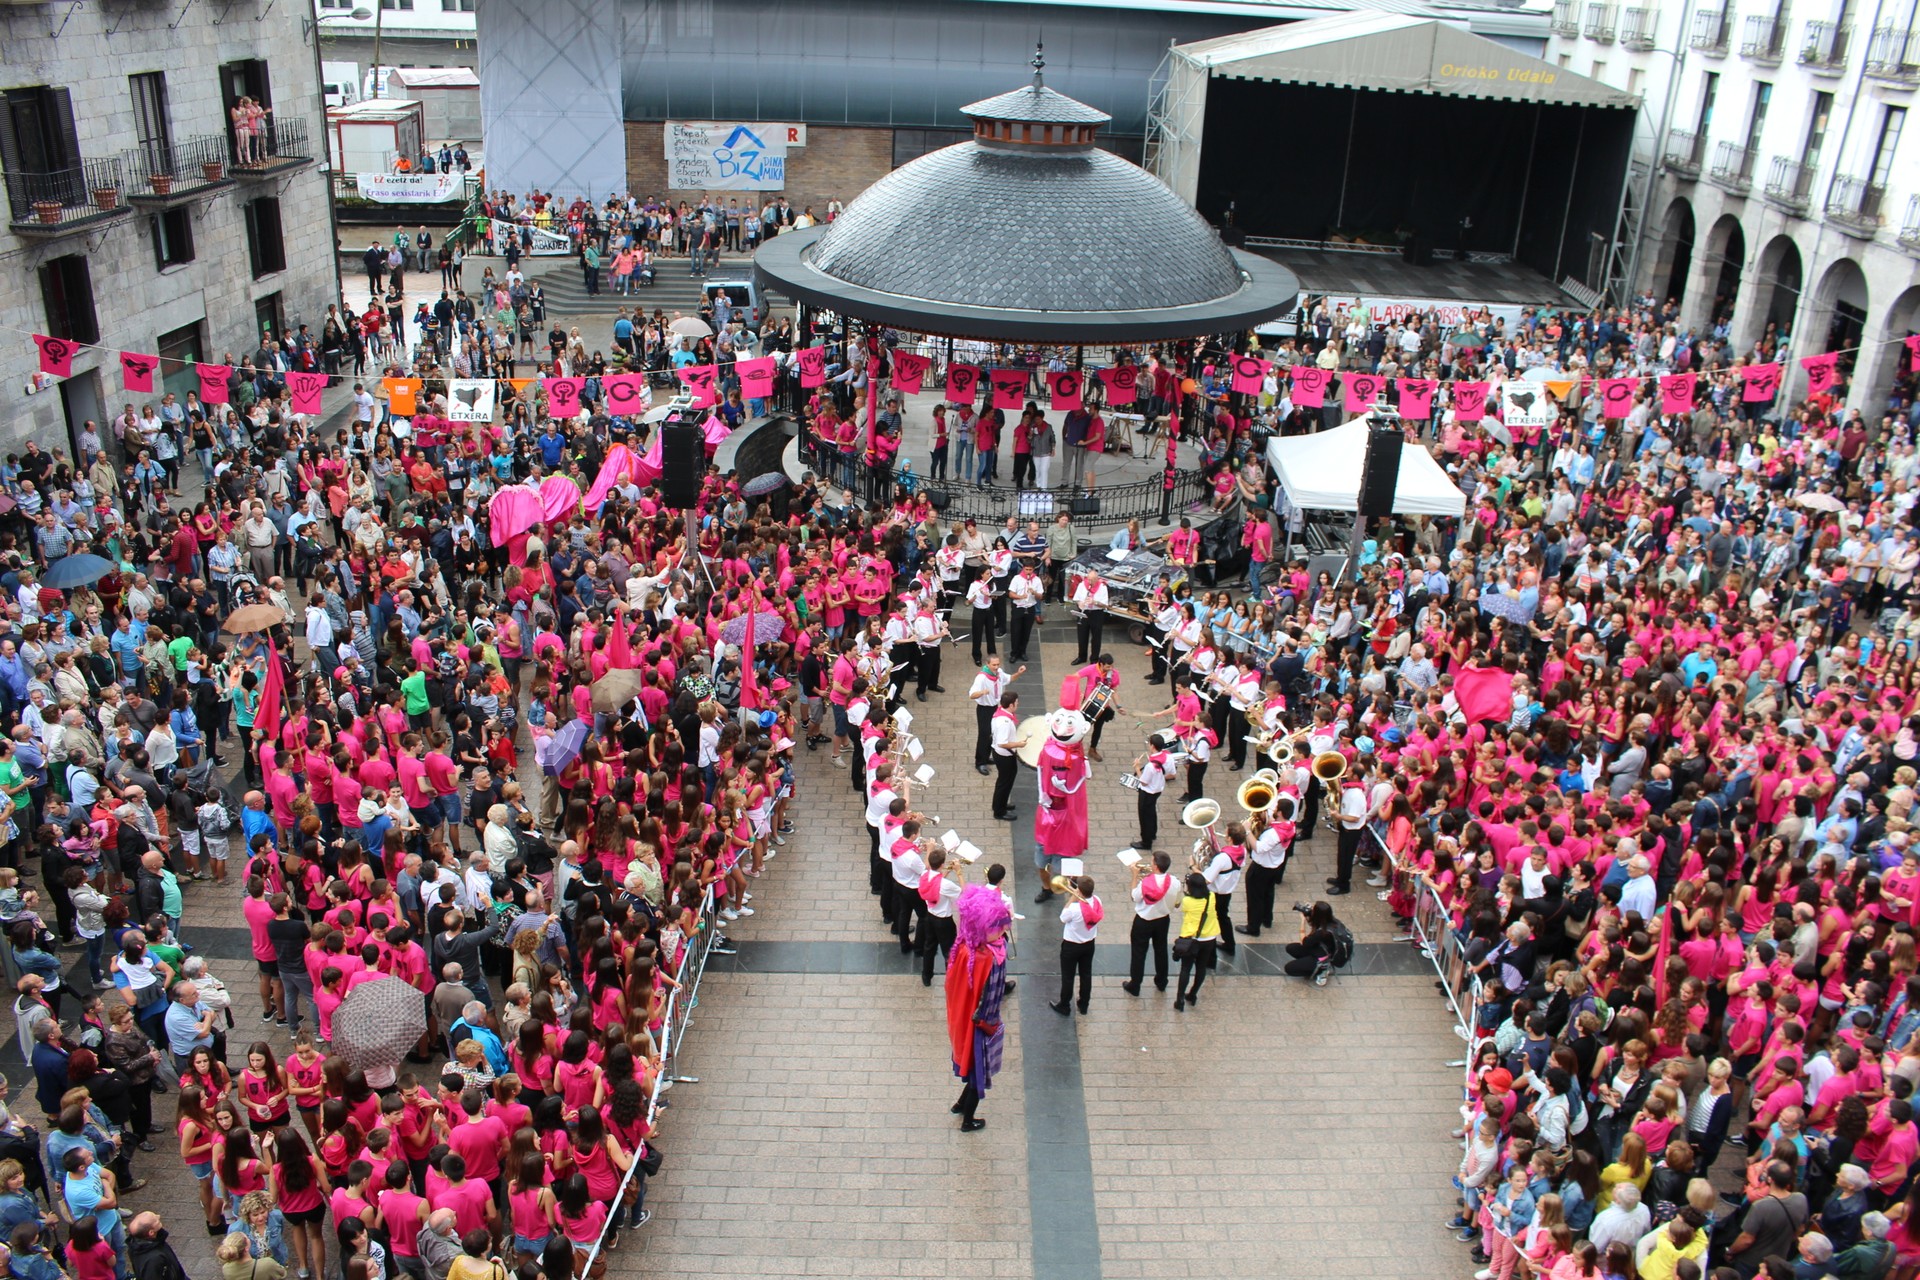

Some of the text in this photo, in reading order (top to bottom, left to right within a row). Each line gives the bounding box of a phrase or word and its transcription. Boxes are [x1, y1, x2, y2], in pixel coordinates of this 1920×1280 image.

[1441, 64, 1556, 84] Orioko Udala
[787, 127, 798, 142] R
[764, 156, 783, 167] DINA
[676, 166, 712, 178] etxerik
[763, 168, 783, 180] MIKA
[374, 175, 385, 184] EZ
[677, 177, 703, 189] gabe
[391, 190, 431, 198] sexistarik
[451, 412, 488, 420] ETXERA
